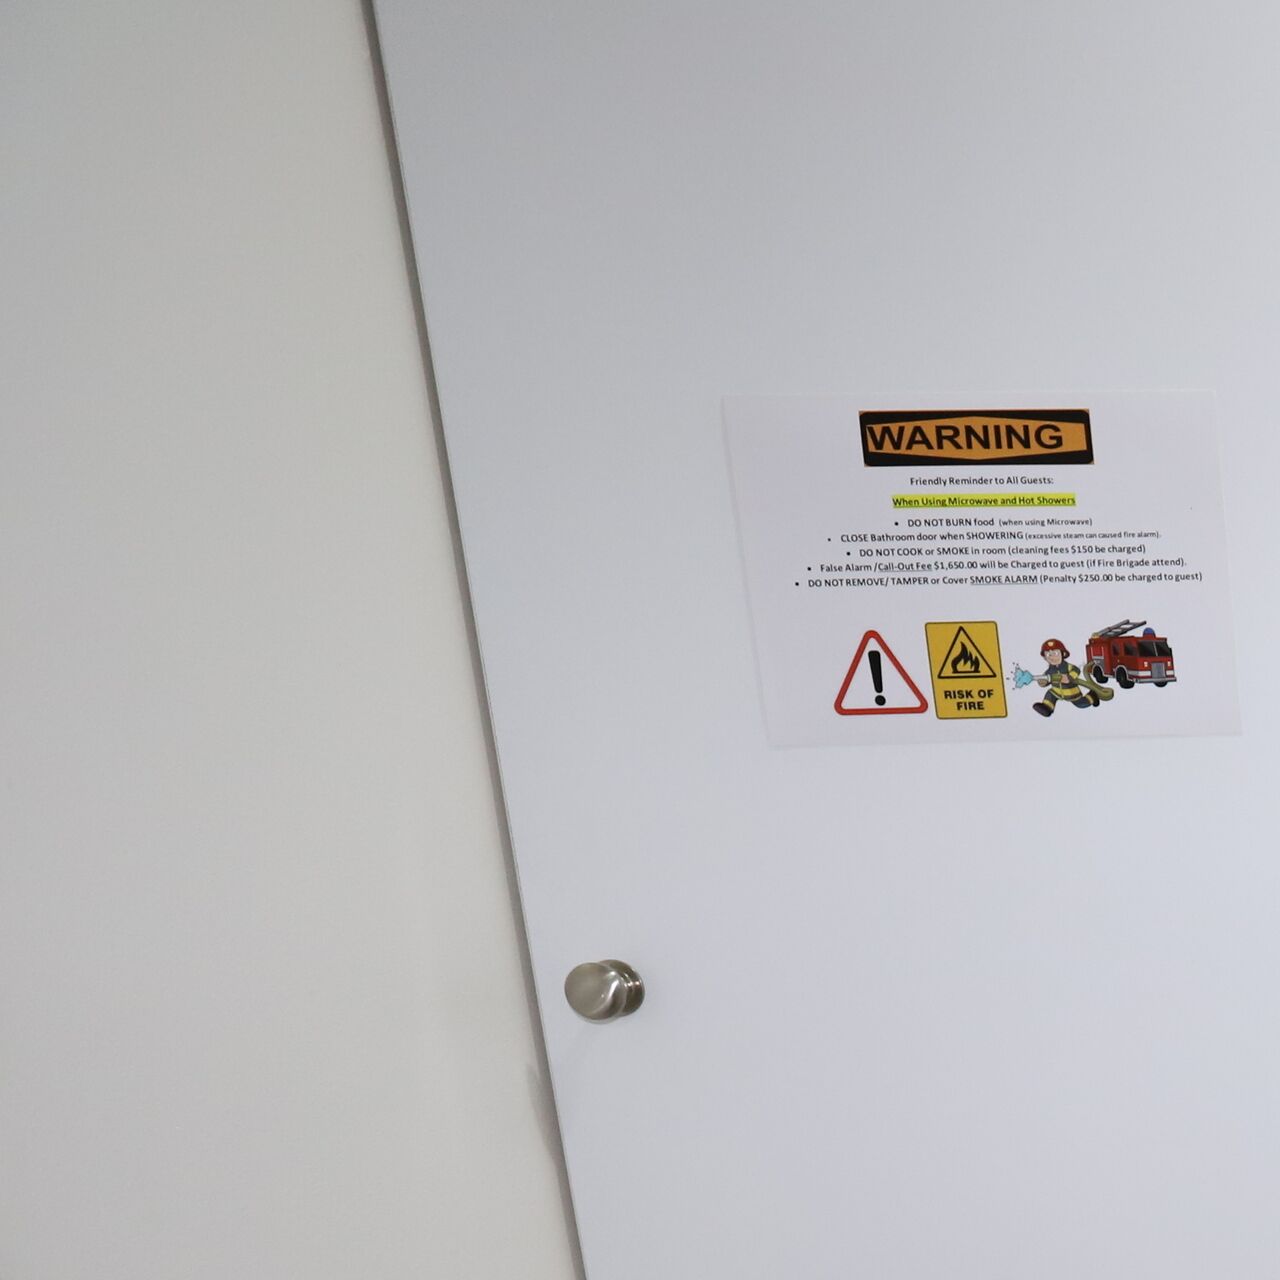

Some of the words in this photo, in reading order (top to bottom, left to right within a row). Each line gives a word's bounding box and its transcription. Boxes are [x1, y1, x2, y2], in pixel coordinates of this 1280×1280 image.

[867, 424, 1063, 450] WARNING
[910, 477, 947, 486] Friendly
[949, 477, 993, 485] Reminder
[1006, 476, 1018, 484] All
[1020, 476, 1054, 485] Guests:
[893, 497, 919, 507] When
[921, 497, 947, 507] Using
[948, 497, 998, 506] Microwave
[1000, 496, 1017, 505] and
[1018, 496, 1035, 505] Hot
[1037, 496, 1076, 505] Showers
[907, 519, 922, 527] DO
[924, 519, 944, 527] NOT
[945, 519, 972, 527] BURN
[973, 518, 994, 526] food
[999, 519, 1023, 527] (when
[1024, 519, 1045, 527] using
[1047, 518, 1093, 527] Microwave)
[840, 534, 868, 543] CLOSE
[870, 533, 916, 543] Bathroom
[917, 533, 937, 541] door
[939, 533, 965, 541] when
[966, 532, 1024, 541] SHOWERING
[1025, 532, 1062, 540] (excessive
[1098, 531, 1122, 539] caused
[1123, 531, 1136, 539] fire
[859, 549, 874, 557] DO
[876, 549, 895, 557] NOT
[896, 549, 923, 557] COOK
[936, 548, 969, 556] SMOKE
[971, 547, 980, 555] in
[1008, 546, 1049, 556] (cleaning
[1050, 546, 1069, 554] fees
[1070, 545, 1093, 555] $150
[1095, 545, 1106, 553] be
[1107, 544, 1146, 555] charged)
[820, 564, 843, 572] False
[845, 563, 872, 572] Alarm
[916, 562, 932, 571] Fee
[934, 561, 978, 571] $1,650.00
[980, 561, 996, 569] will
[997, 560, 1009, 569] be
[1010, 560, 1048, 570] Charged
[1060, 561, 1085, 570] guest
[1086, 559, 1096, 569] (if
[1098, 559, 1114, 568] Fire
[1116, 559, 1150, 568] Brigade
[808, 579, 822, 587] DO
[824, 579, 844, 587] NOT
[892, 577, 929, 586] TAMPER
[942, 577, 968, 585] Cover
[970, 576, 1003, 585] SMOKE
[1004, 575, 1038, 585] ALARM
[1039, 574, 1077, 584] (Penalty
[1078, 573, 1113, 584] $250.00
[1115, 573, 1125, 582] be
[1127, 573, 1163, 583] charged
[1175, 572, 1203, 583] guest)
[944, 689, 974, 699] RISK
[977, 689, 994, 699] OF
[956, 701, 985, 711] FIRE
